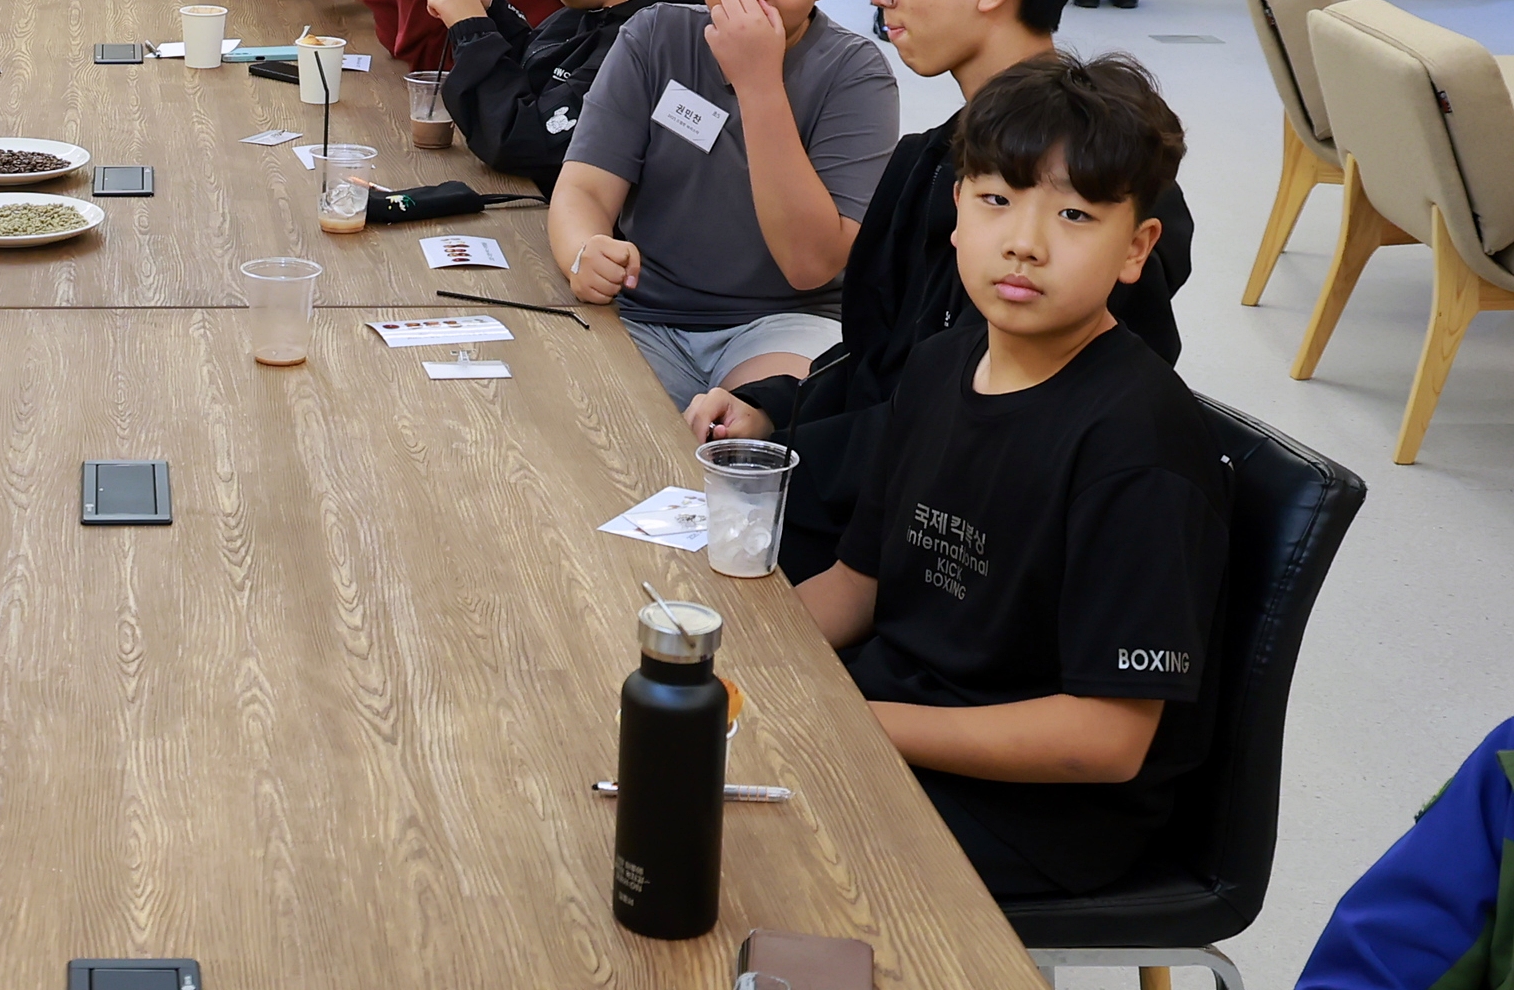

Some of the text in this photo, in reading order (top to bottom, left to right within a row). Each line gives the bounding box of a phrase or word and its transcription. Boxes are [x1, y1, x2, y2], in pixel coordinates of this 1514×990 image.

[675, 104, 702, 125] 권민찬
[937, 557, 963, 581] KICK
[925, 569, 966, 600] BOXING
[1118, 648, 1191, 674] BOXING
